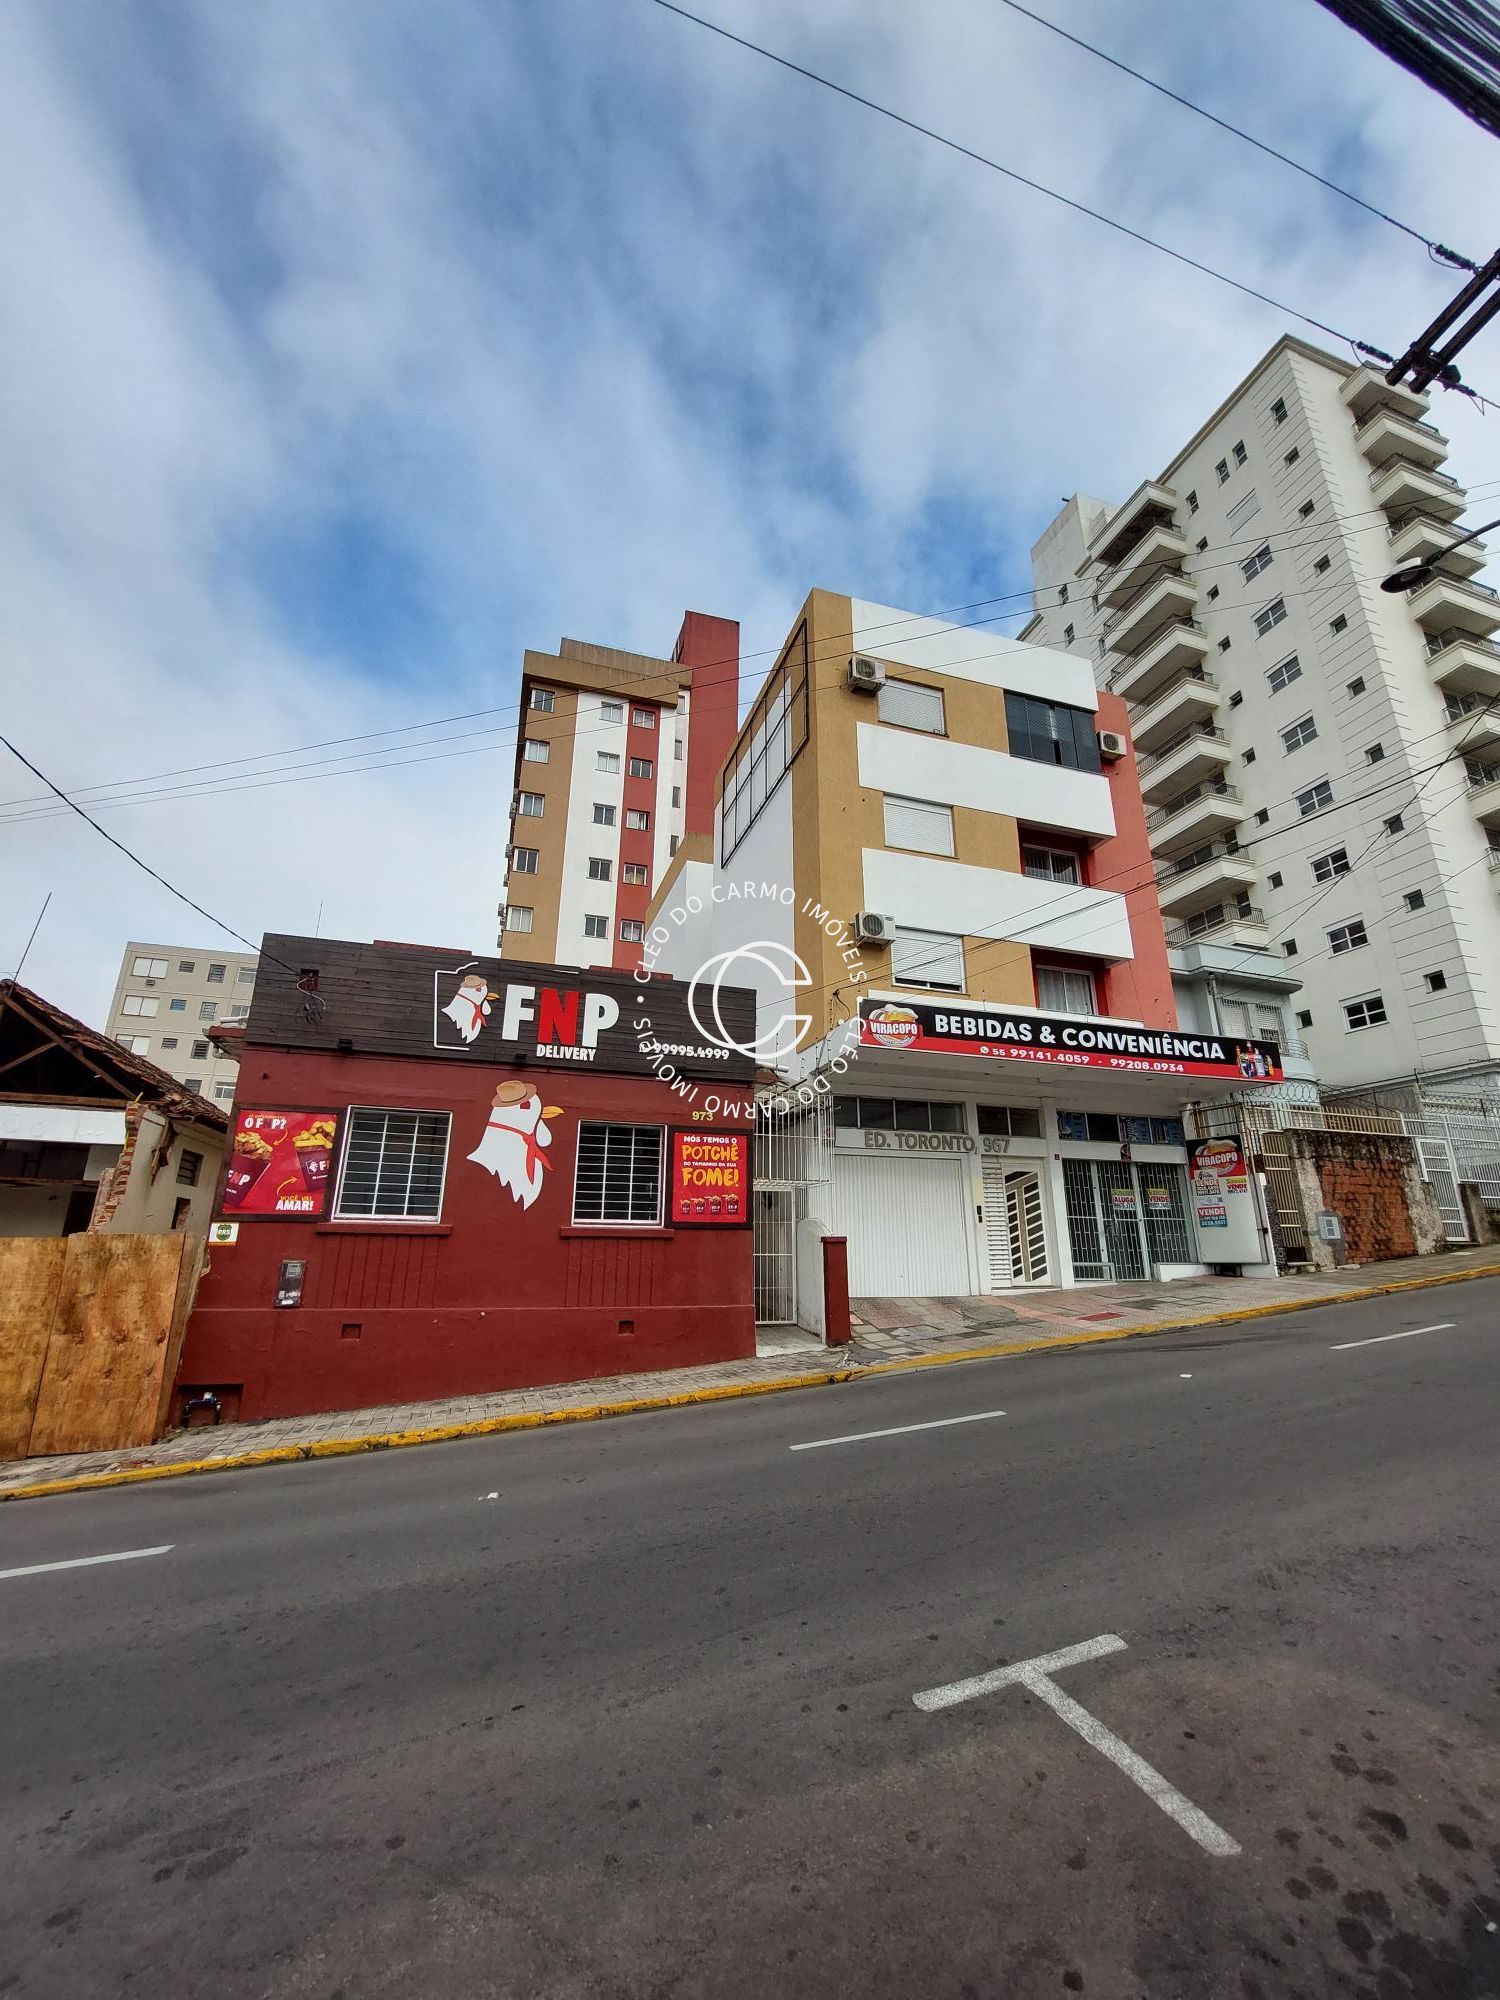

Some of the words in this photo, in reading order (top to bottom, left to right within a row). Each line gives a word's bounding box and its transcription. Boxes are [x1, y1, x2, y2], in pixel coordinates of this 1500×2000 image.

[502, 984, 620, 1047] FNP
[870, 1022, 918, 1035] VIRACOPO
[935, 1014, 1033, 1041] BEBIDAS
[1039, 1025, 1056, 1044] &
[1062, 1028, 1226, 1060] CONVENIÊNCIA
[536, 1045, 597, 1061] DELIVERY
[654, 1043, 729, 1059] 99995.4999
[992, 1048, 1006, 1056] 55
[1010, 1049, 1090, 1064] 99141.4059
[1110, 1058, 1185, 1073] 99208.0934
[244, 1117, 254, 1129] O
[692, 1111, 714, 1121] 973
[683, 1135, 701, 1143] NÓS
[703, 1136, 729, 1144] TEMOS
[864, 1131, 891, 1148] ED.
[895, 1133, 977, 1154] TORONTO,
[983, 1137, 1010, 1154] 967
[682, 1144, 739, 1161] POTCHÊ
[1197, 1152, 1238, 1167] VIRACOPO
[682, 1168, 739, 1187] FOME!
[275, 1200, 315, 1211] AMAR!
[1198, 1207, 1226, 1216] VENDE
